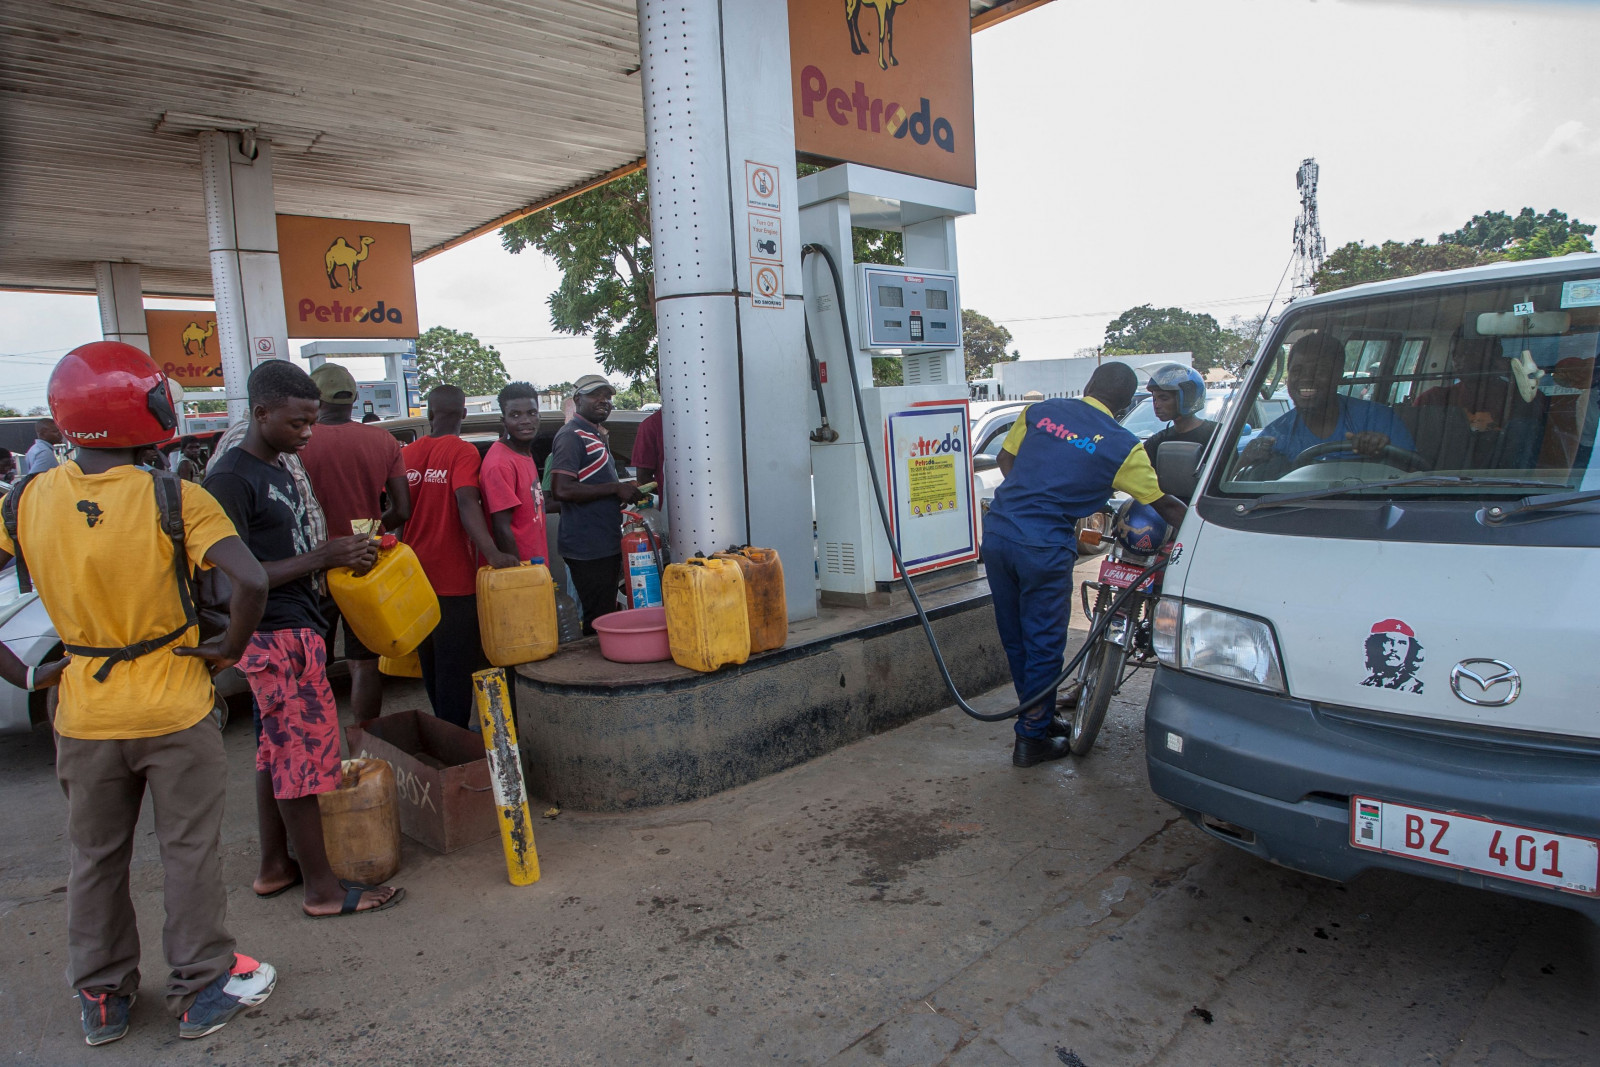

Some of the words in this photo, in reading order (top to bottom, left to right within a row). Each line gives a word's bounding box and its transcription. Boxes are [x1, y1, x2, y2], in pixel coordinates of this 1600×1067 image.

[801, 65, 954, 153] Petroda
[299, 299, 403, 324] Petroda
[163, 362, 223, 378] Petrod
[64, 430, 108, 440] LIFAN
[1036, 417, 1097, 455] Petroda
[1103, 569, 1125, 580] LIFAN
[1124, 572, 1151, 585] MOR
[396, 766, 438, 816] BOX
[1359, 815, 1380, 823] MALAWI
[1405, 814, 1450, 855] BZ
[1488, 830, 1563, 878] 401
